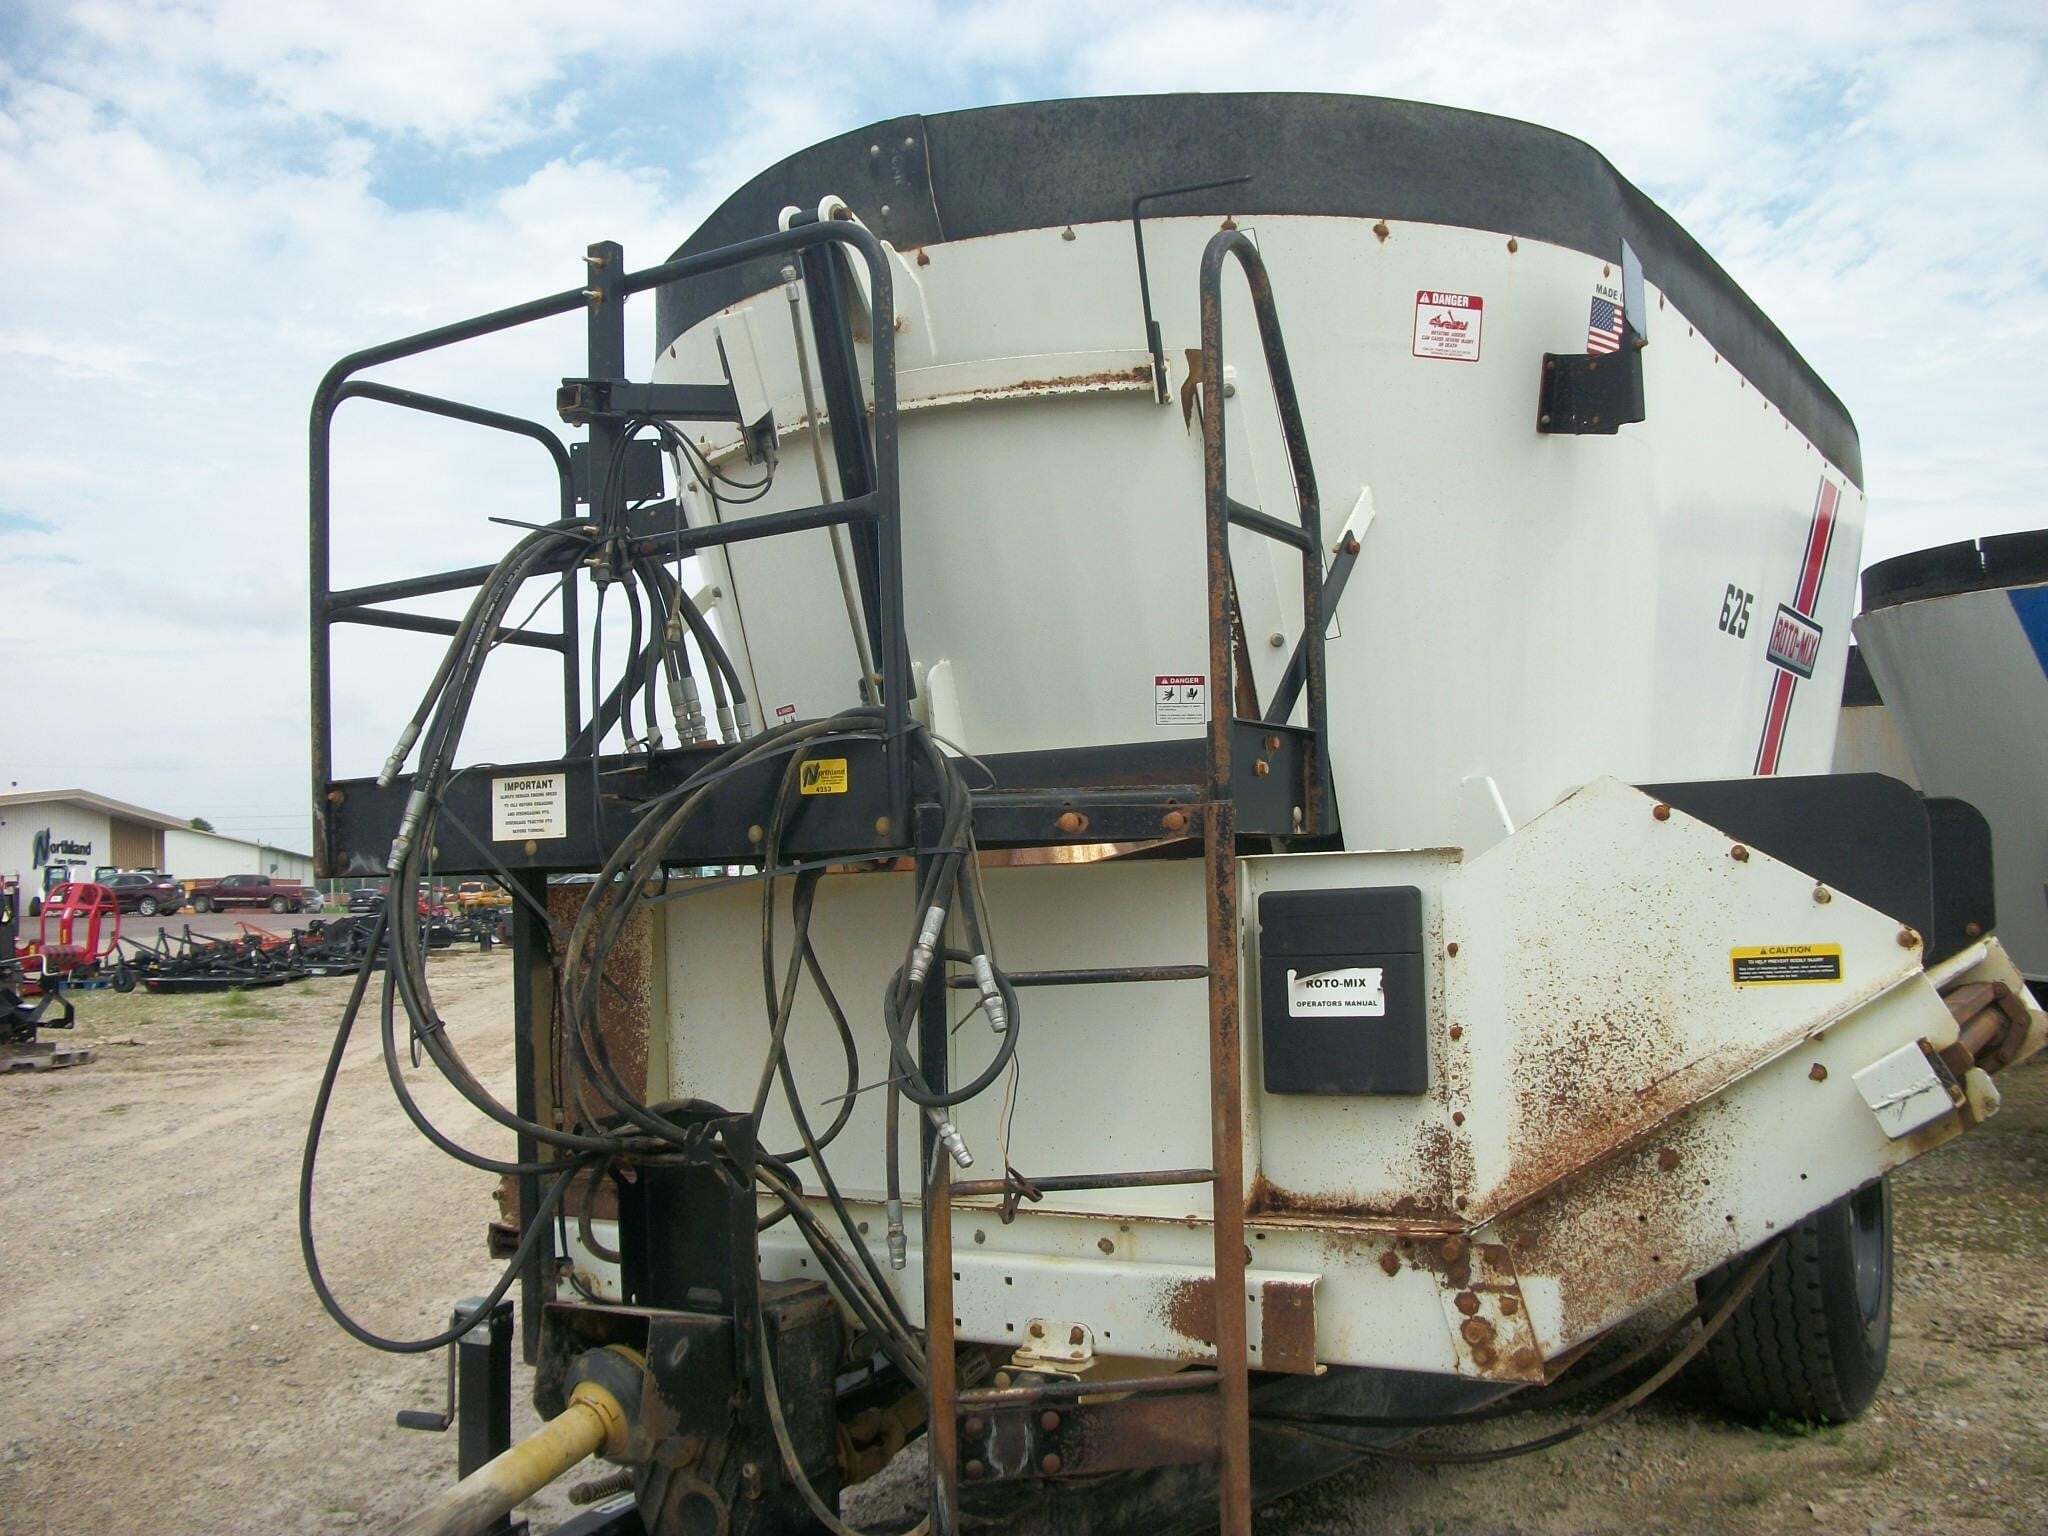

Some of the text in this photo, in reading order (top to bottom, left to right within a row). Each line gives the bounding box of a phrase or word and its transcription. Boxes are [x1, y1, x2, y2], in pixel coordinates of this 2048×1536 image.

[1595, 283, 1618, 300] MADE
[1432, 293, 1469, 308] DANGER
[1718, 583, 1754, 639] 625
[1771, 615, 1819, 668] ROTO-MIX
[802, 762, 846, 788] Northland
[504, 780, 553, 791] IMPORTANT
[33, 827, 91, 870] Northland
[1768, 945, 1811, 955] CAUTION
[1306, 978, 1366, 988] ROTO-MIX
